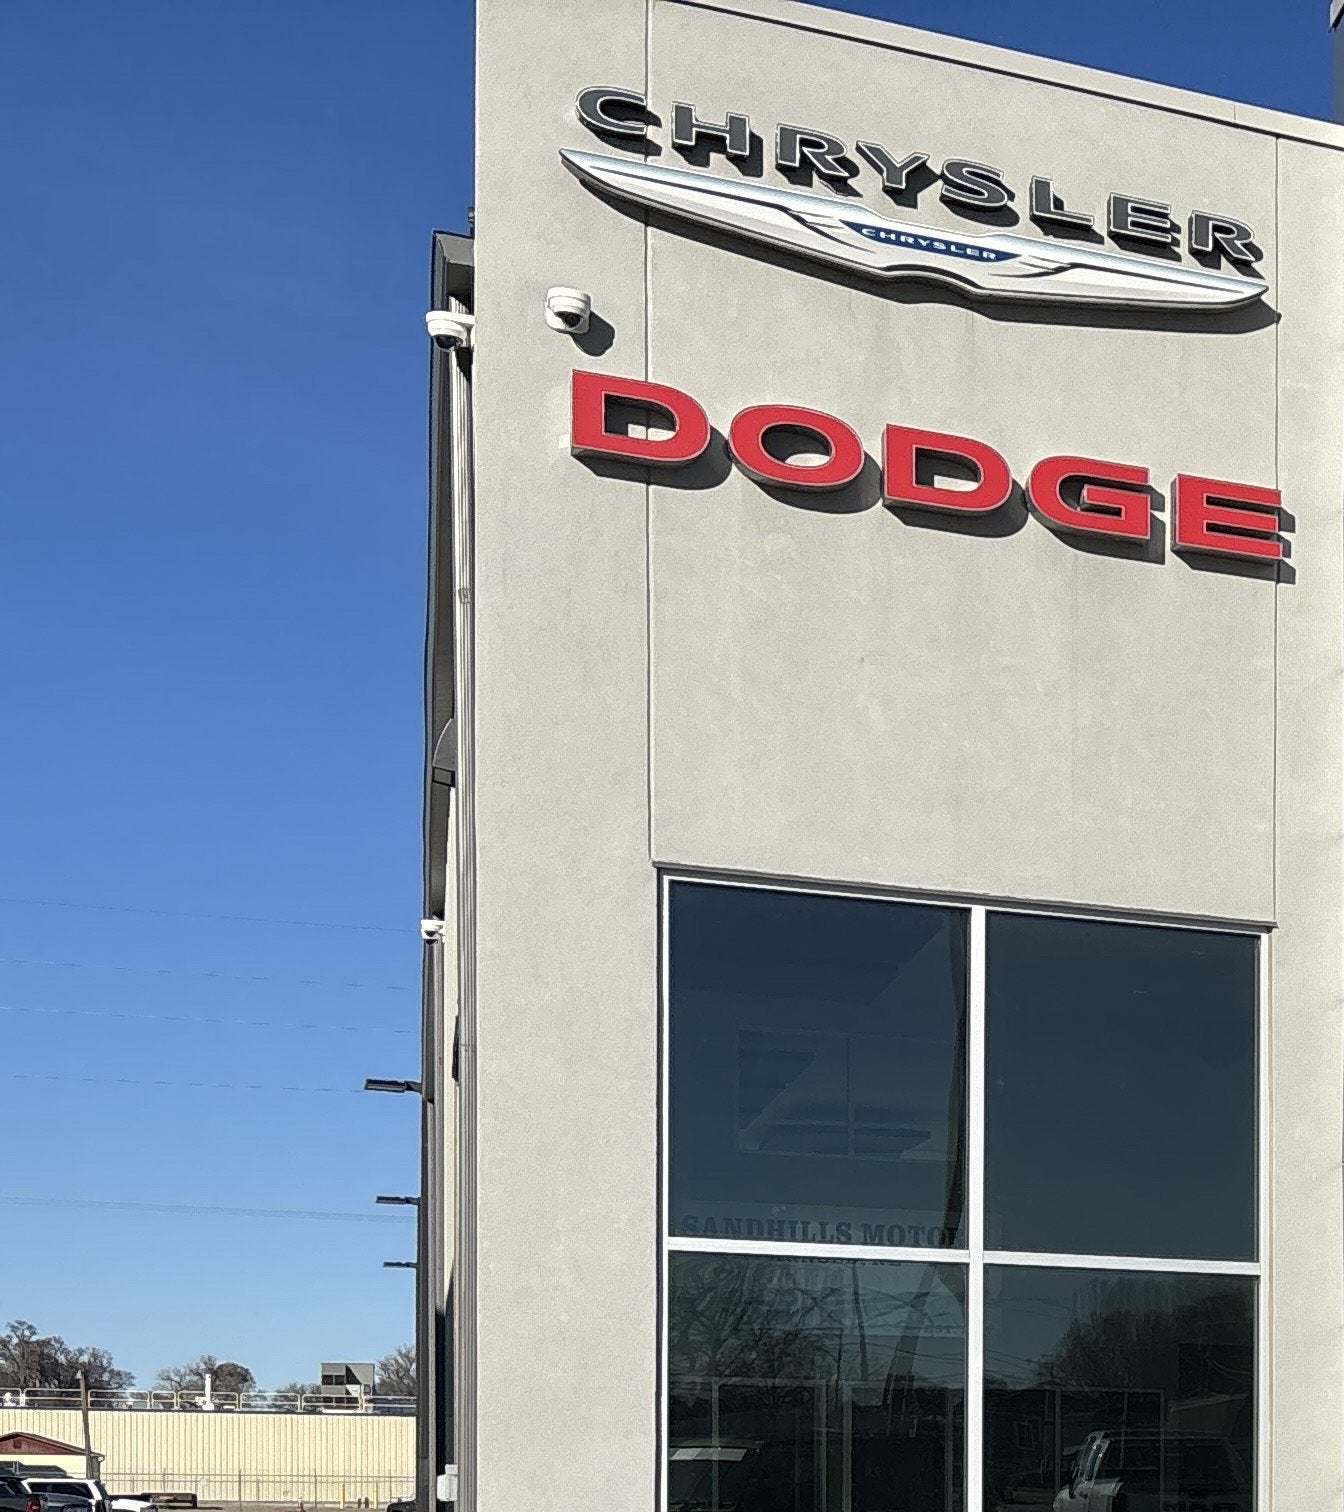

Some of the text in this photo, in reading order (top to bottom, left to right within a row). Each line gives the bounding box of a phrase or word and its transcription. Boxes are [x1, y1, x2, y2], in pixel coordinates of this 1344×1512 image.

[574, 86, 1261, 270] CHRYSLER
[861, 227, 997, 262] CHRYSLER
[570, 369, 1284, 562] DODGE
[682, 1213, 853, 1244] SANDHILLS
